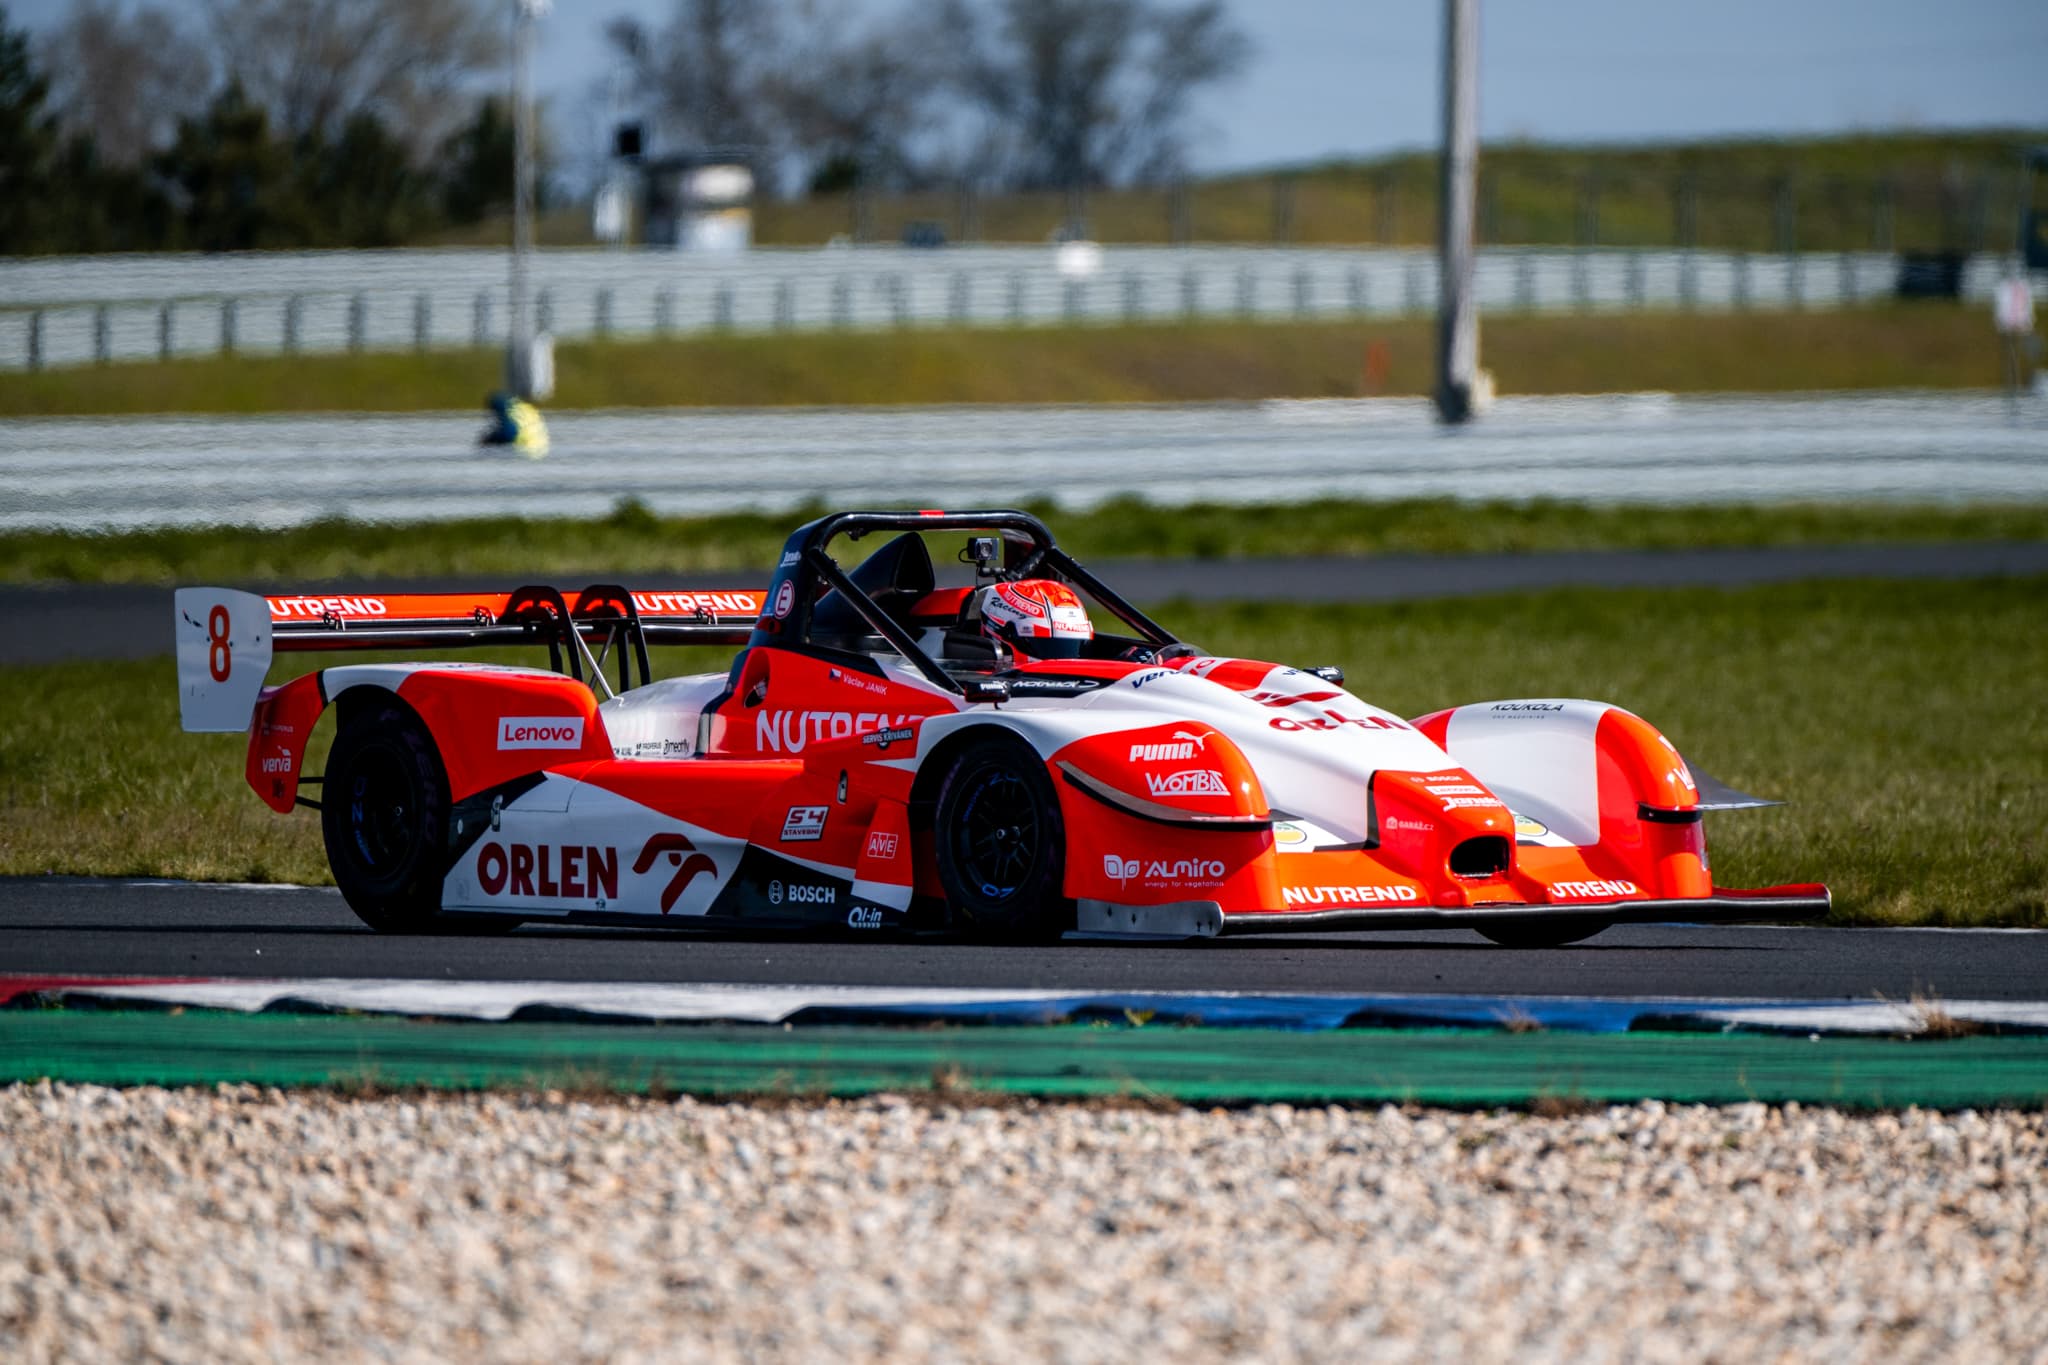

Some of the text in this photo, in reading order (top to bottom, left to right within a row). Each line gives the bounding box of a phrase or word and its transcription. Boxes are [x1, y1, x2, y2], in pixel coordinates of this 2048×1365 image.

[267, 598, 387, 616] UTREND
[990, 597, 1027, 619] Racing
[208, 604, 231, 683] 8
[1490, 703, 1565, 712] KOUKOLA
[1268, 709, 1412, 732] ORLEN
[504, 724, 576, 742] Lenovo
[1129, 743, 1194, 762] PUMA
[262, 757, 292, 773] verva
[868, 837, 896, 853] AVE
[477, 842, 618, 899] ORLEN
[788, 884, 836, 903] BOSCH
[1282, 886, 1417, 904] NUTREND
